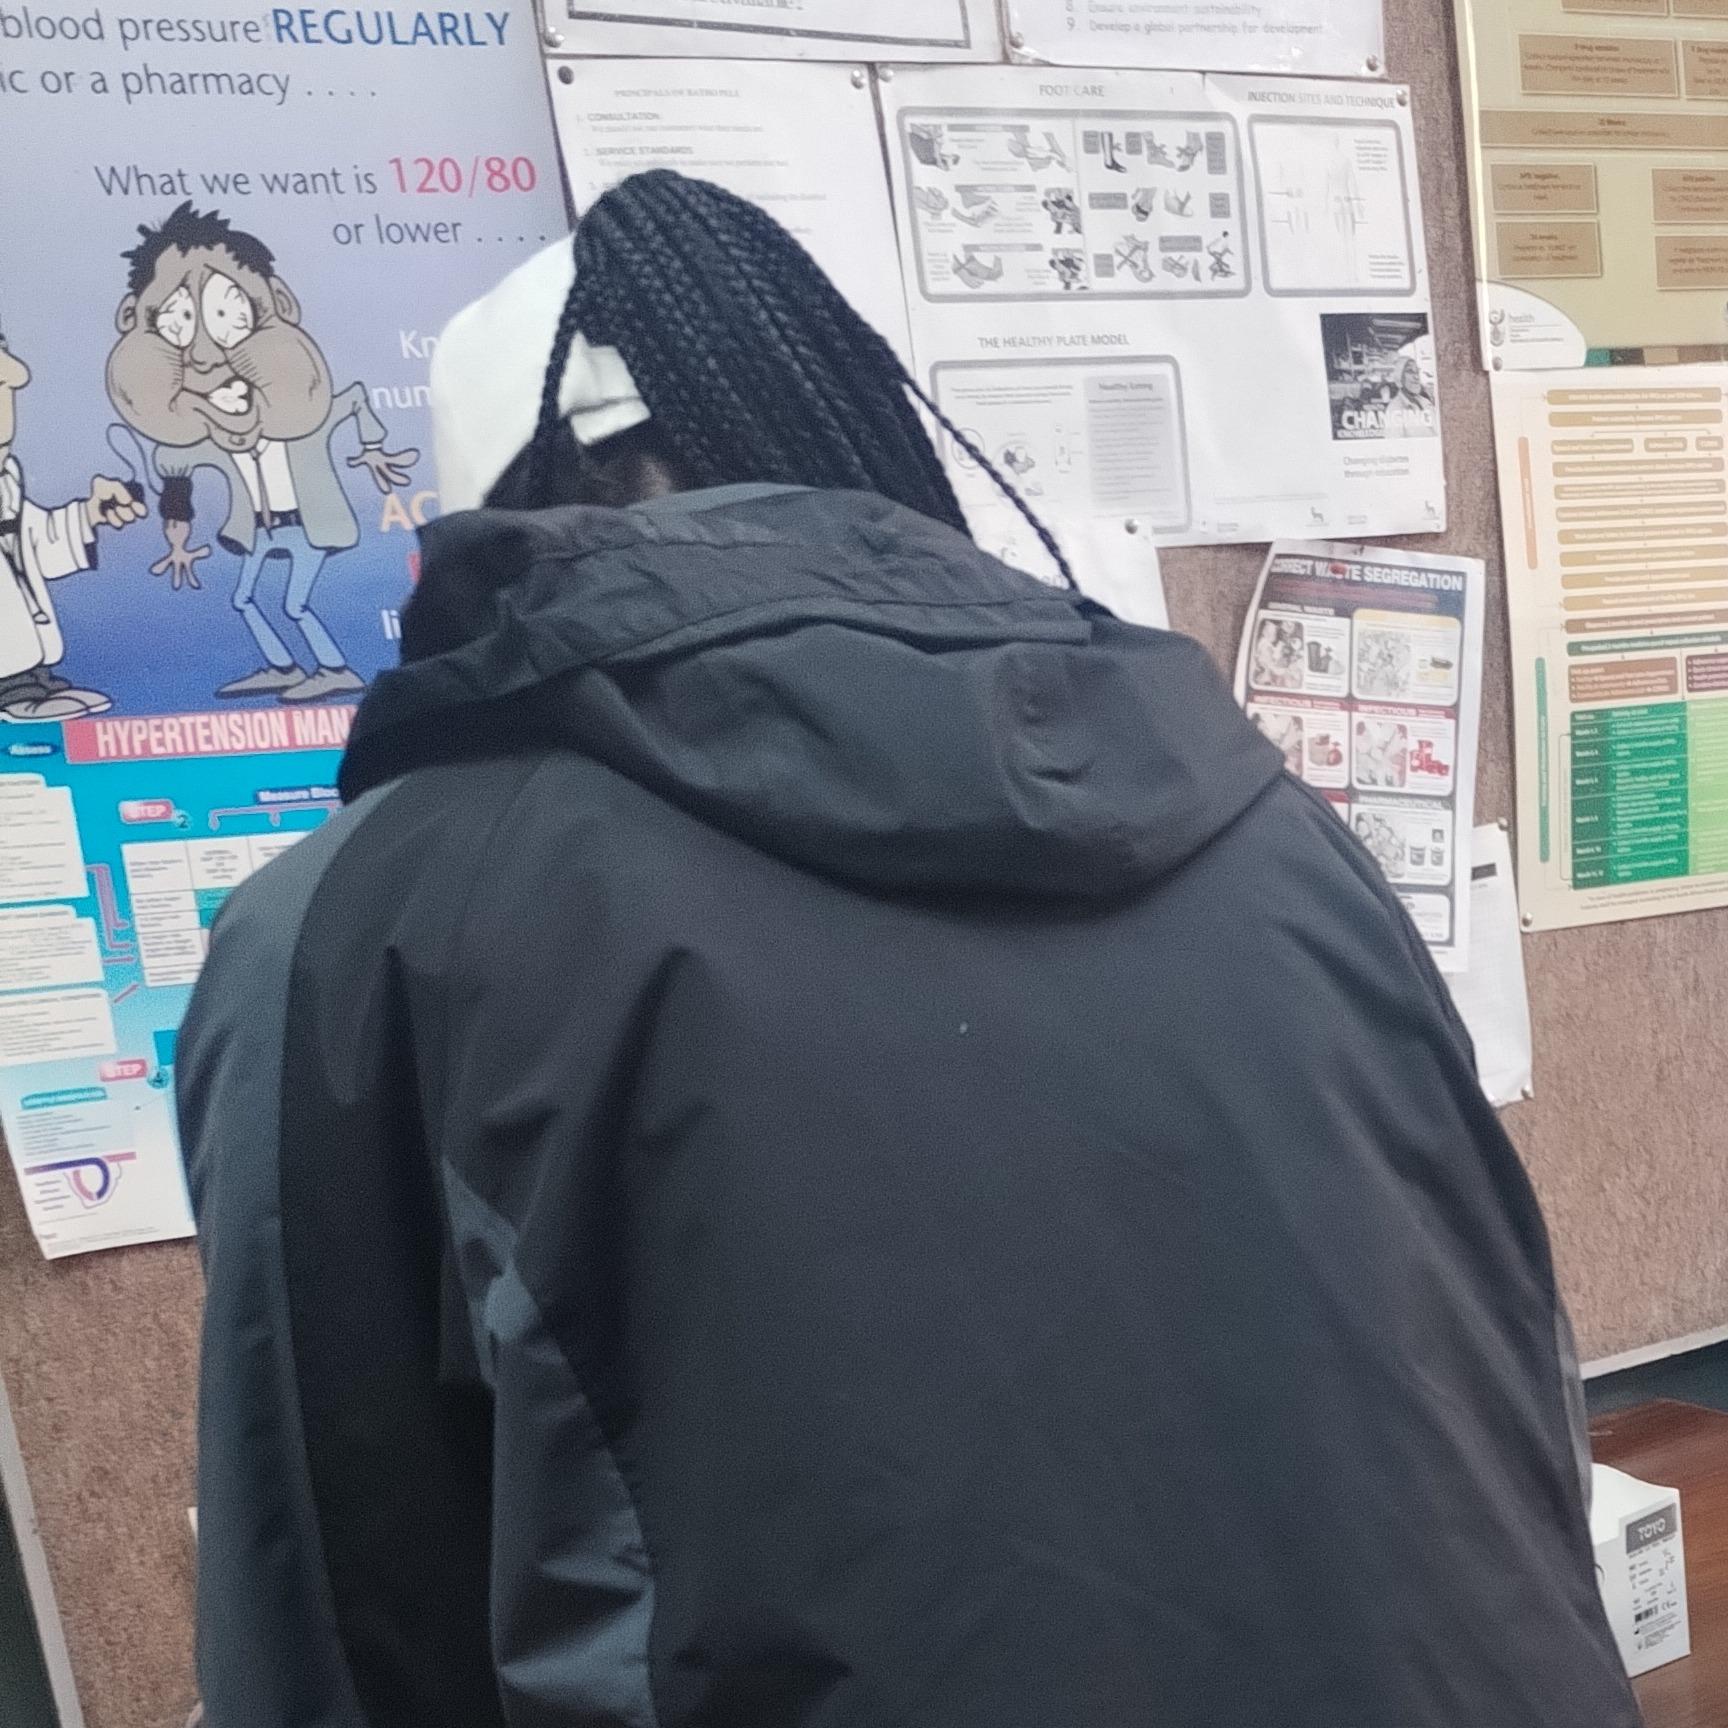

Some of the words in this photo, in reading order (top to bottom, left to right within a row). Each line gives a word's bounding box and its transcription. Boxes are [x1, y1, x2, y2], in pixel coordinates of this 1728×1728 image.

[0, 5, 104, 41] blood
[118, 14, 262, 51] pressure
[271, 9, 510, 47] REGULARLY
[40, 70, 76, 94] or
[89, 71, 110, 95] a
[121, 66, 290, 106] pharmacy
[95, 165, 192, 196] What
[201, 172, 250, 195] we
[260, 167, 342, 196] want
[354, 166, 378, 195] is
[389, 156, 537, 198] 120/80
[332, 223, 364, 245] or
[375, 213, 462, 244] lower
[977, 337, 1000, 349] THE
[1003, 336, 1055, 348] HEALTHY
[1056, 334, 1089, 347] PLATE
[1091, 333, 1130, 346] MODEL
[1315, 560, 1362, 581] WATE
[1363, 565, 1464, 591] SEGREGATION
[96, 710, 289, 759] HYPERTENSION
[126, 803, 167, 819] STEP
[178, 814, 189, 829] 2
